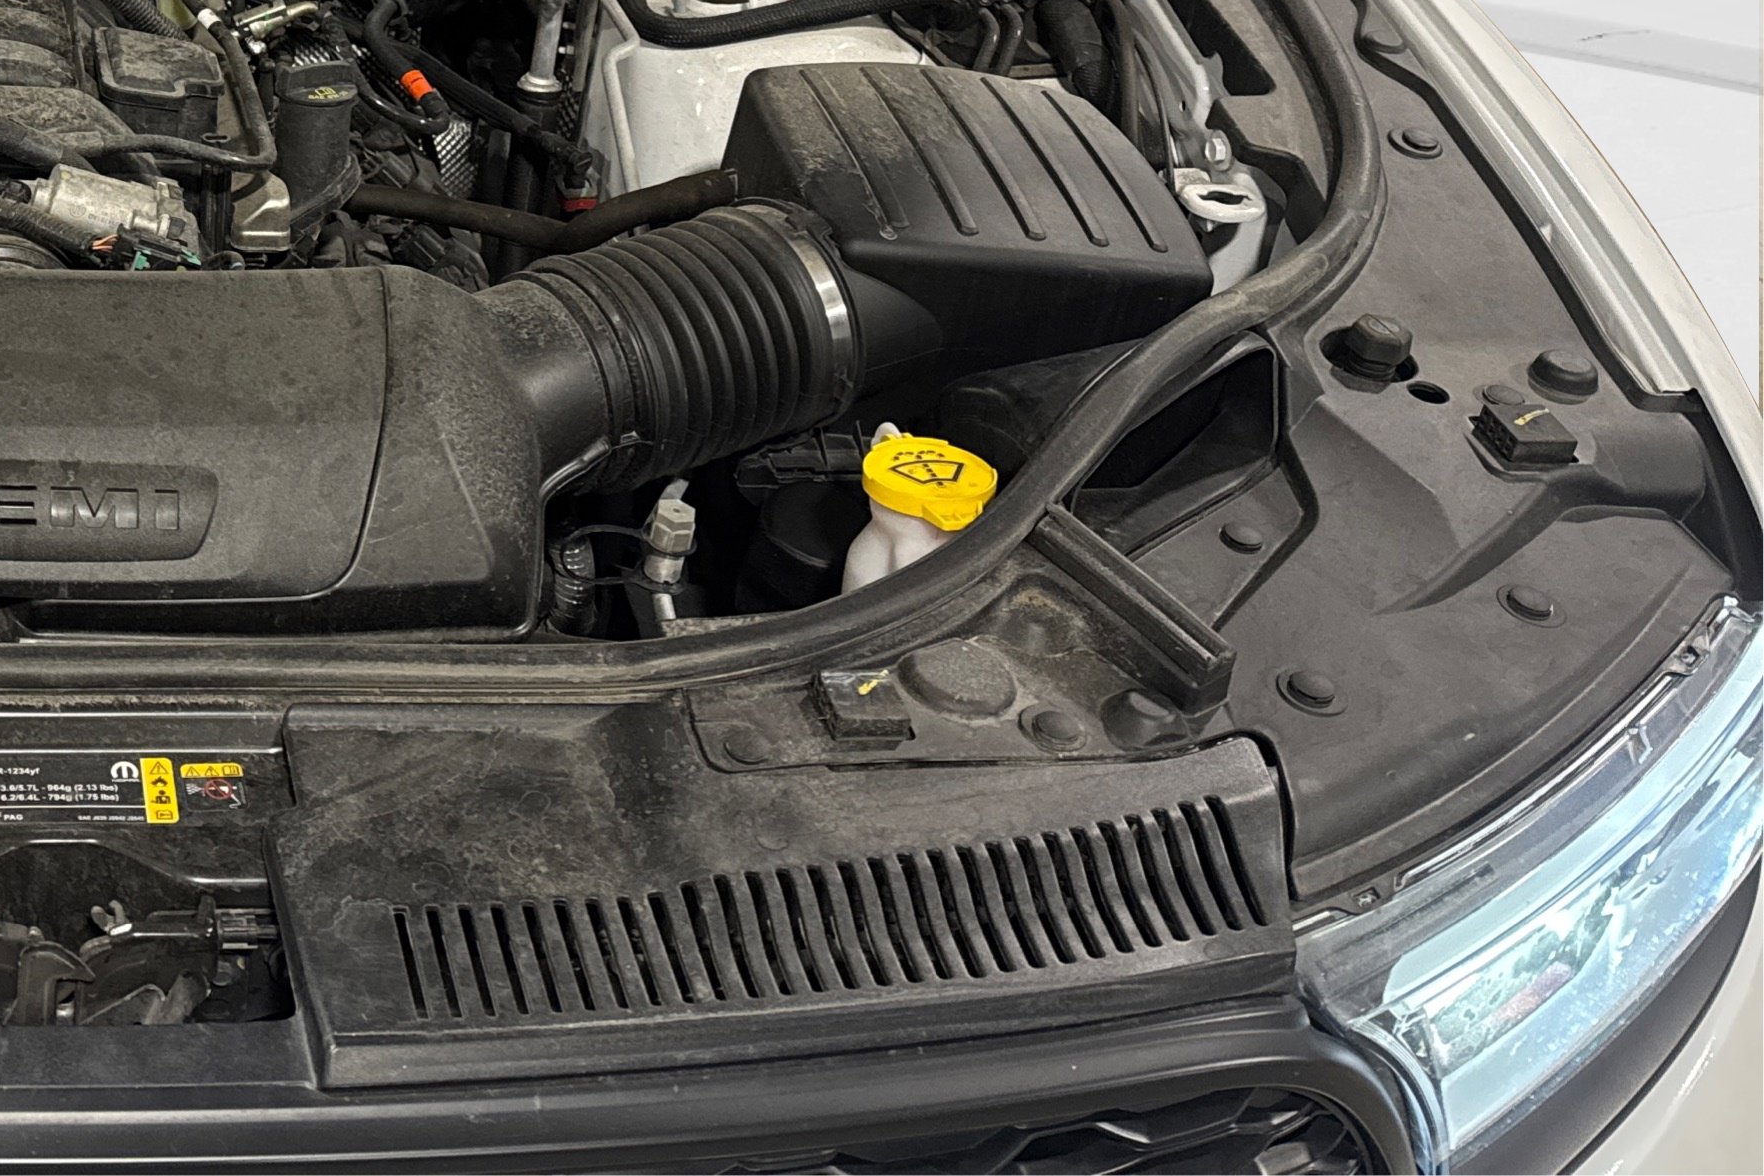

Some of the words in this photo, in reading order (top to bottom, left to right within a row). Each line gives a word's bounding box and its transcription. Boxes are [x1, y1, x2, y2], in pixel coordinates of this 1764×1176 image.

[73, 784, 98, 793] (2.13
[99, 784, 119, 793] lbs)
[74, 793, 99, 802] (1.75
[100, 794, 120, 802] lbs)
